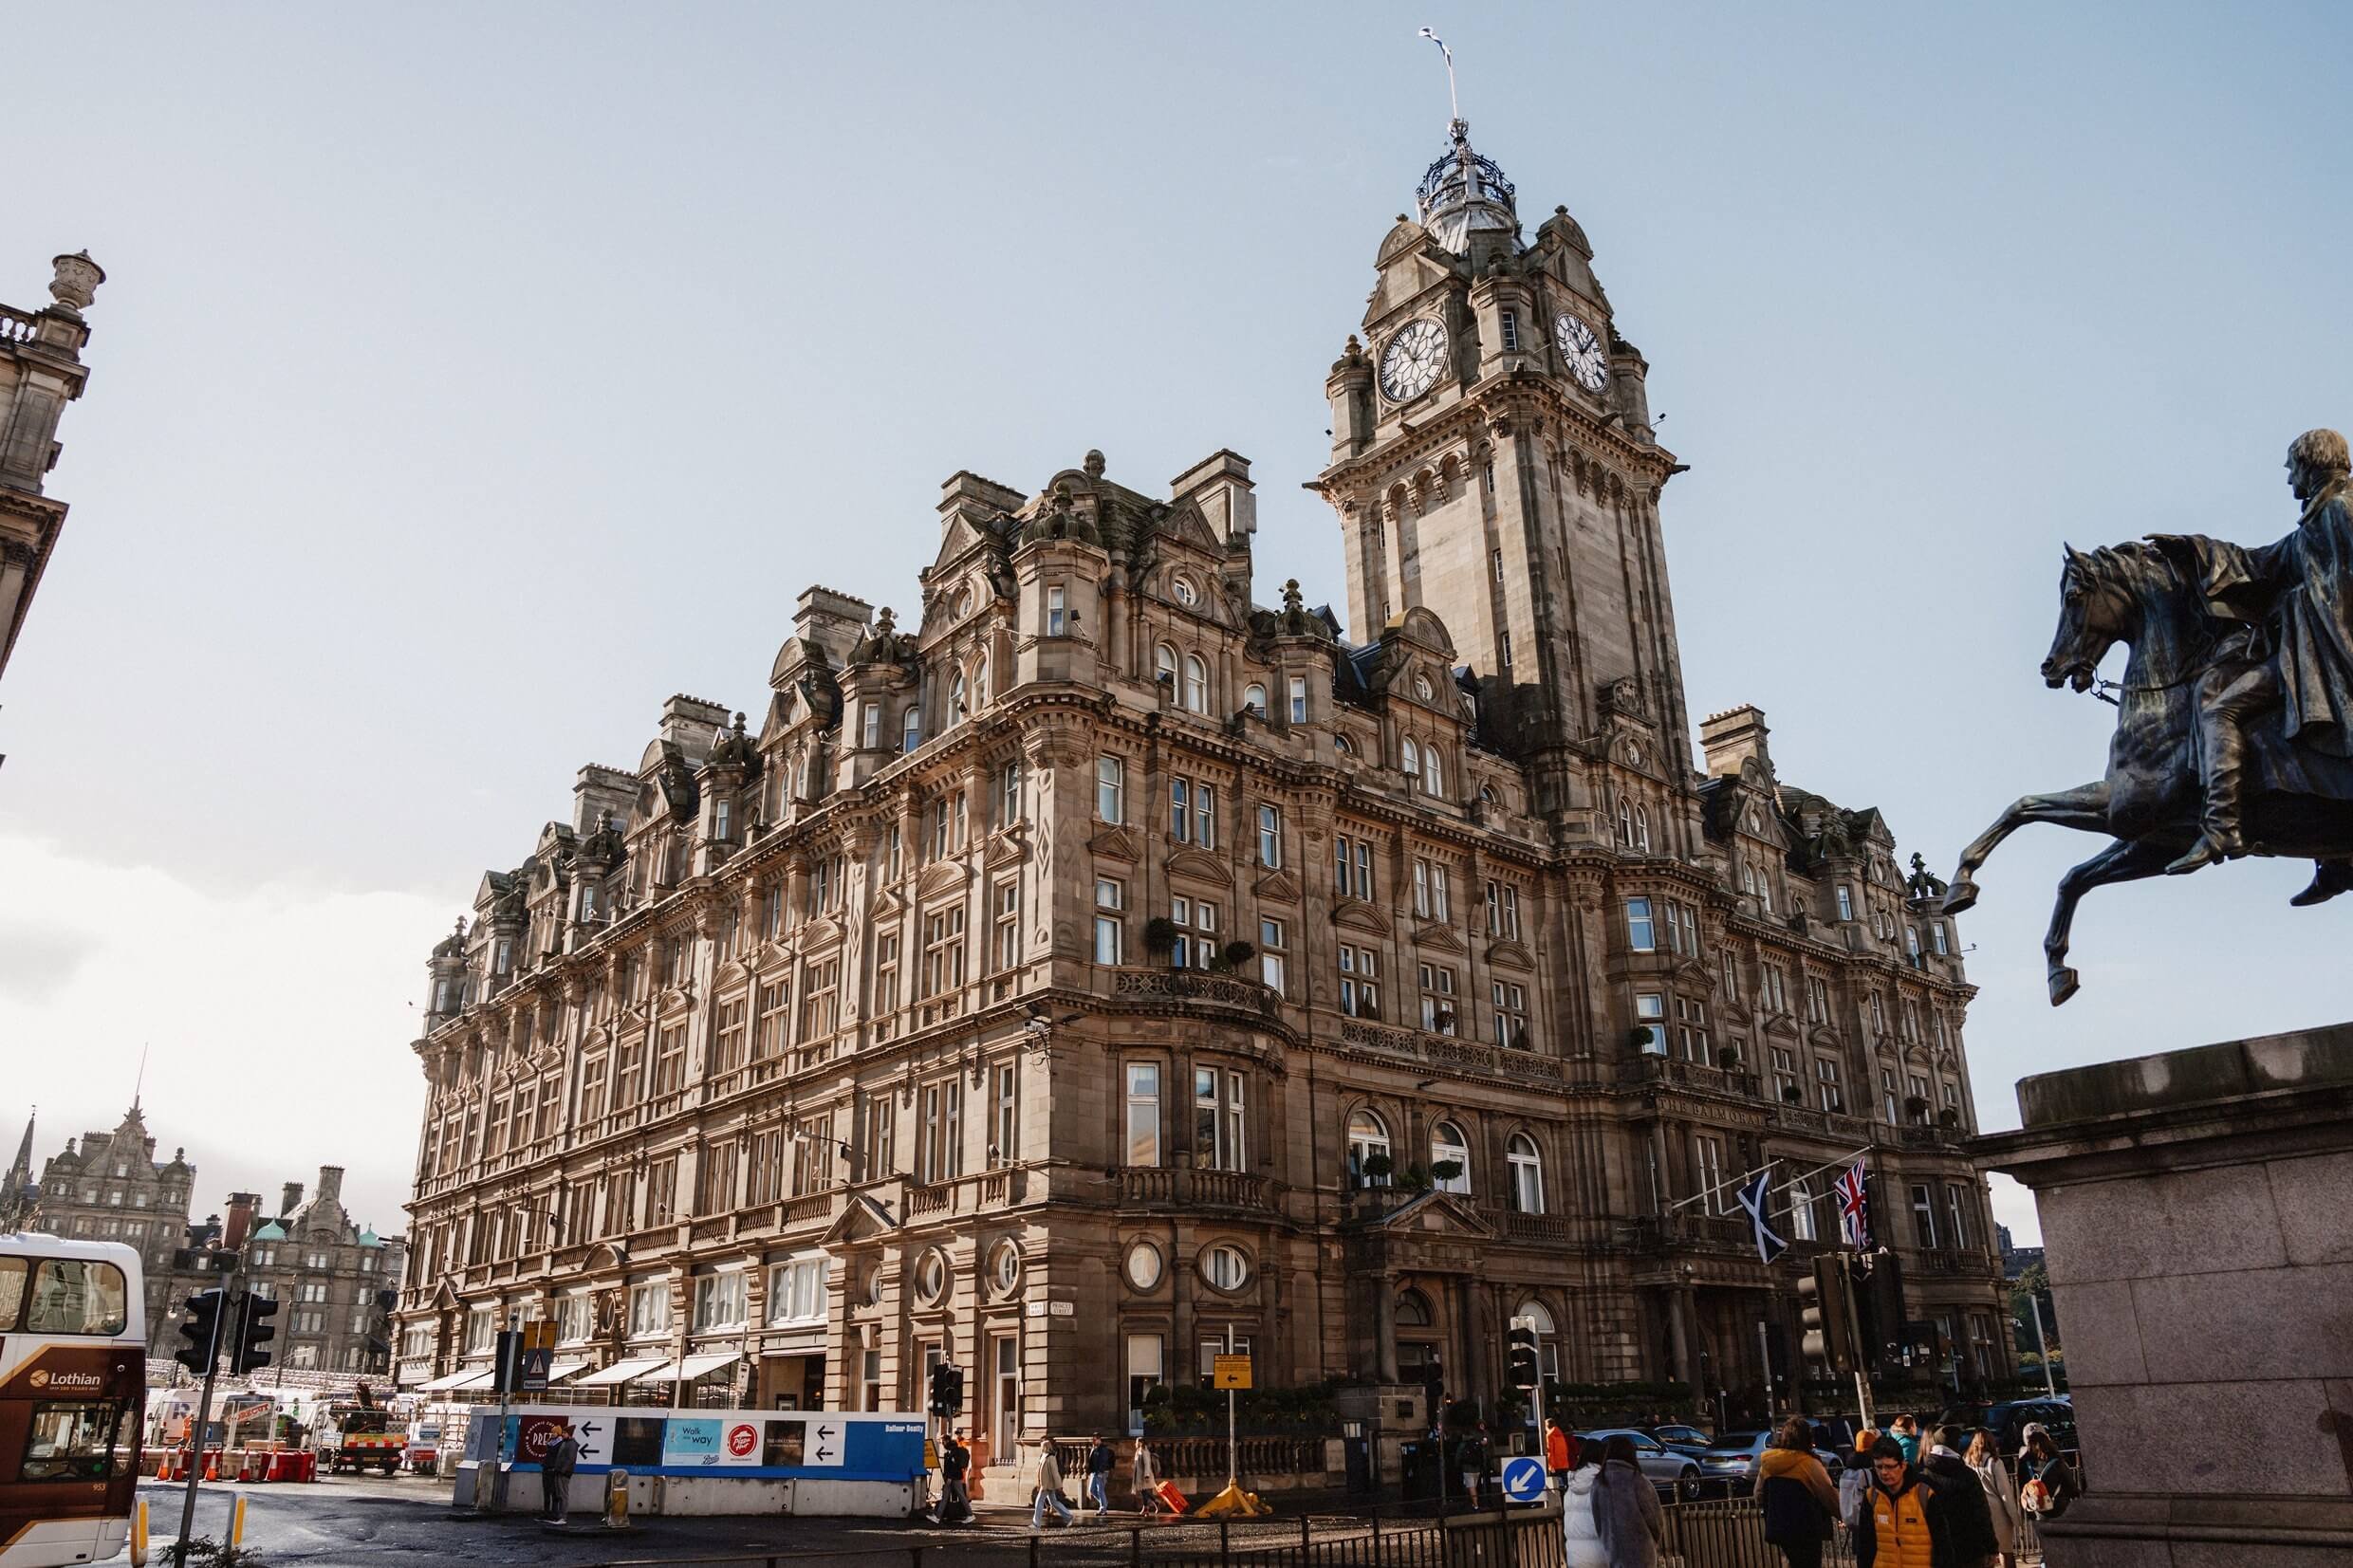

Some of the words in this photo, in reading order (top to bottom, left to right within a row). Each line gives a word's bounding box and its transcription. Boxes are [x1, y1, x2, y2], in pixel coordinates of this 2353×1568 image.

[1658, 1097, 1686, 1113] THE
[1692, 1102, 1762, 1126] BALMORAL
[50, 1372, 102, 1385] Lothian
[682, 1427, 702, 1435] Walk
[532, 1432, 553, 1446] PRET
[692, 1436, 713, 1447] way
[92, 1483, 106, 1491] 953
